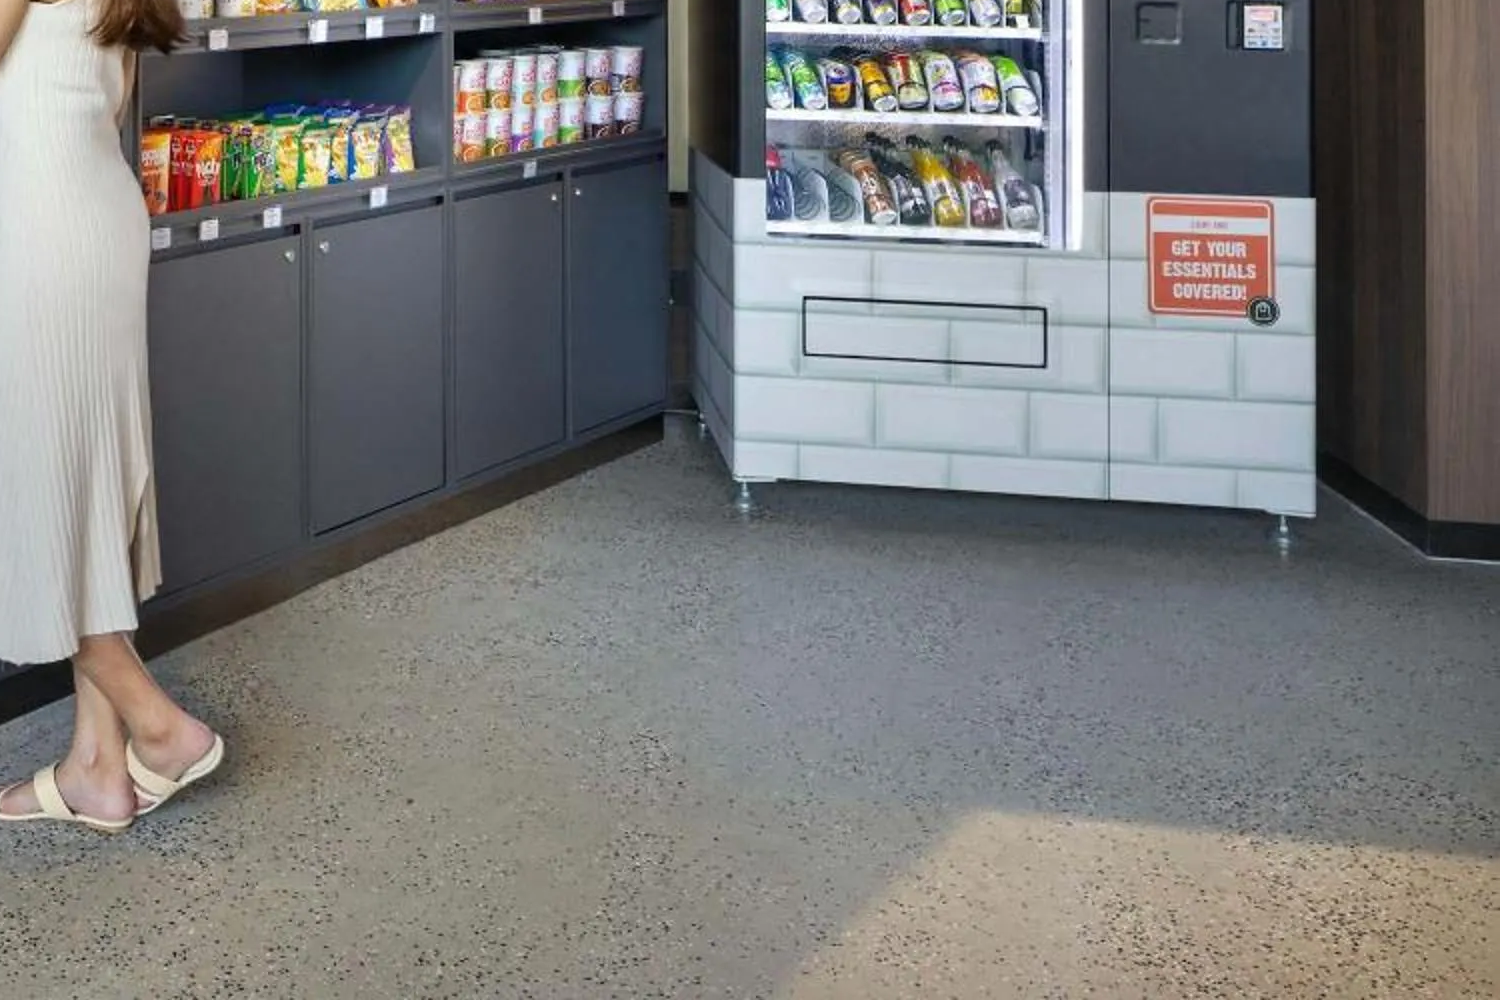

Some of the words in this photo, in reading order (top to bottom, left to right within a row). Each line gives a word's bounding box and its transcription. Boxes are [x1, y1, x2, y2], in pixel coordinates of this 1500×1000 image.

[1171, 240, 1201, 257] GET
[1207, 240, 1247, 258] YOUR
[1162, 261, 1257, 279] ESSENTIALS
[1172, 283, 1247, 301] COVERED!
